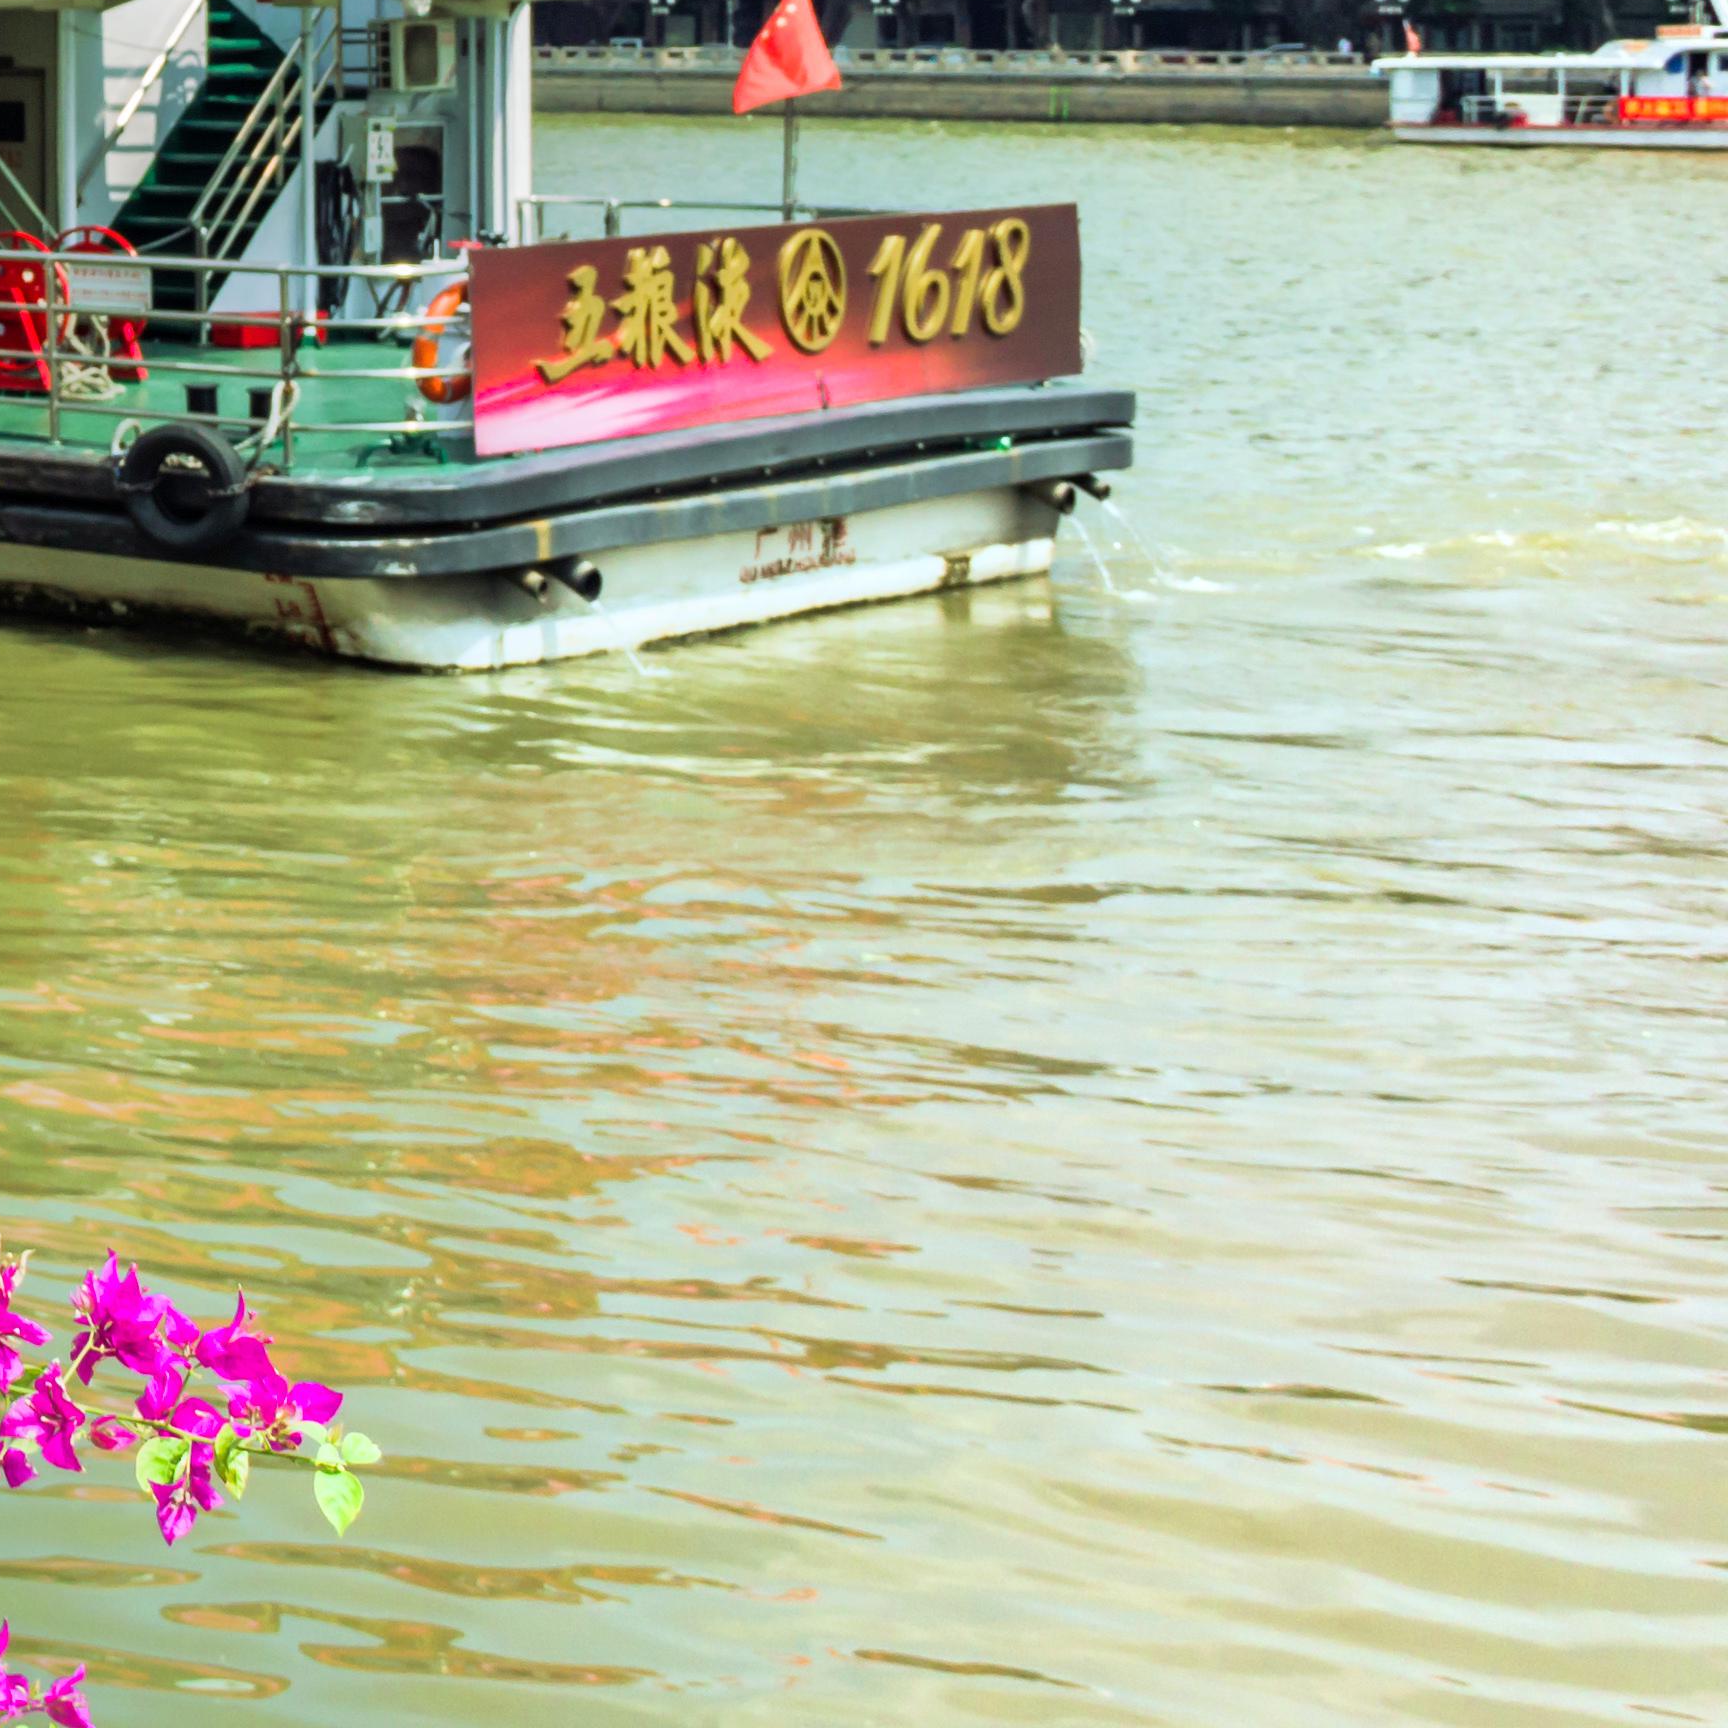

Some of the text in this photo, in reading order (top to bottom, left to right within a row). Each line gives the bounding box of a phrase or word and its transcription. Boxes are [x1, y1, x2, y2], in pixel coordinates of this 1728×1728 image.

[534, 217, 1030, 383] 五粮液 1618
